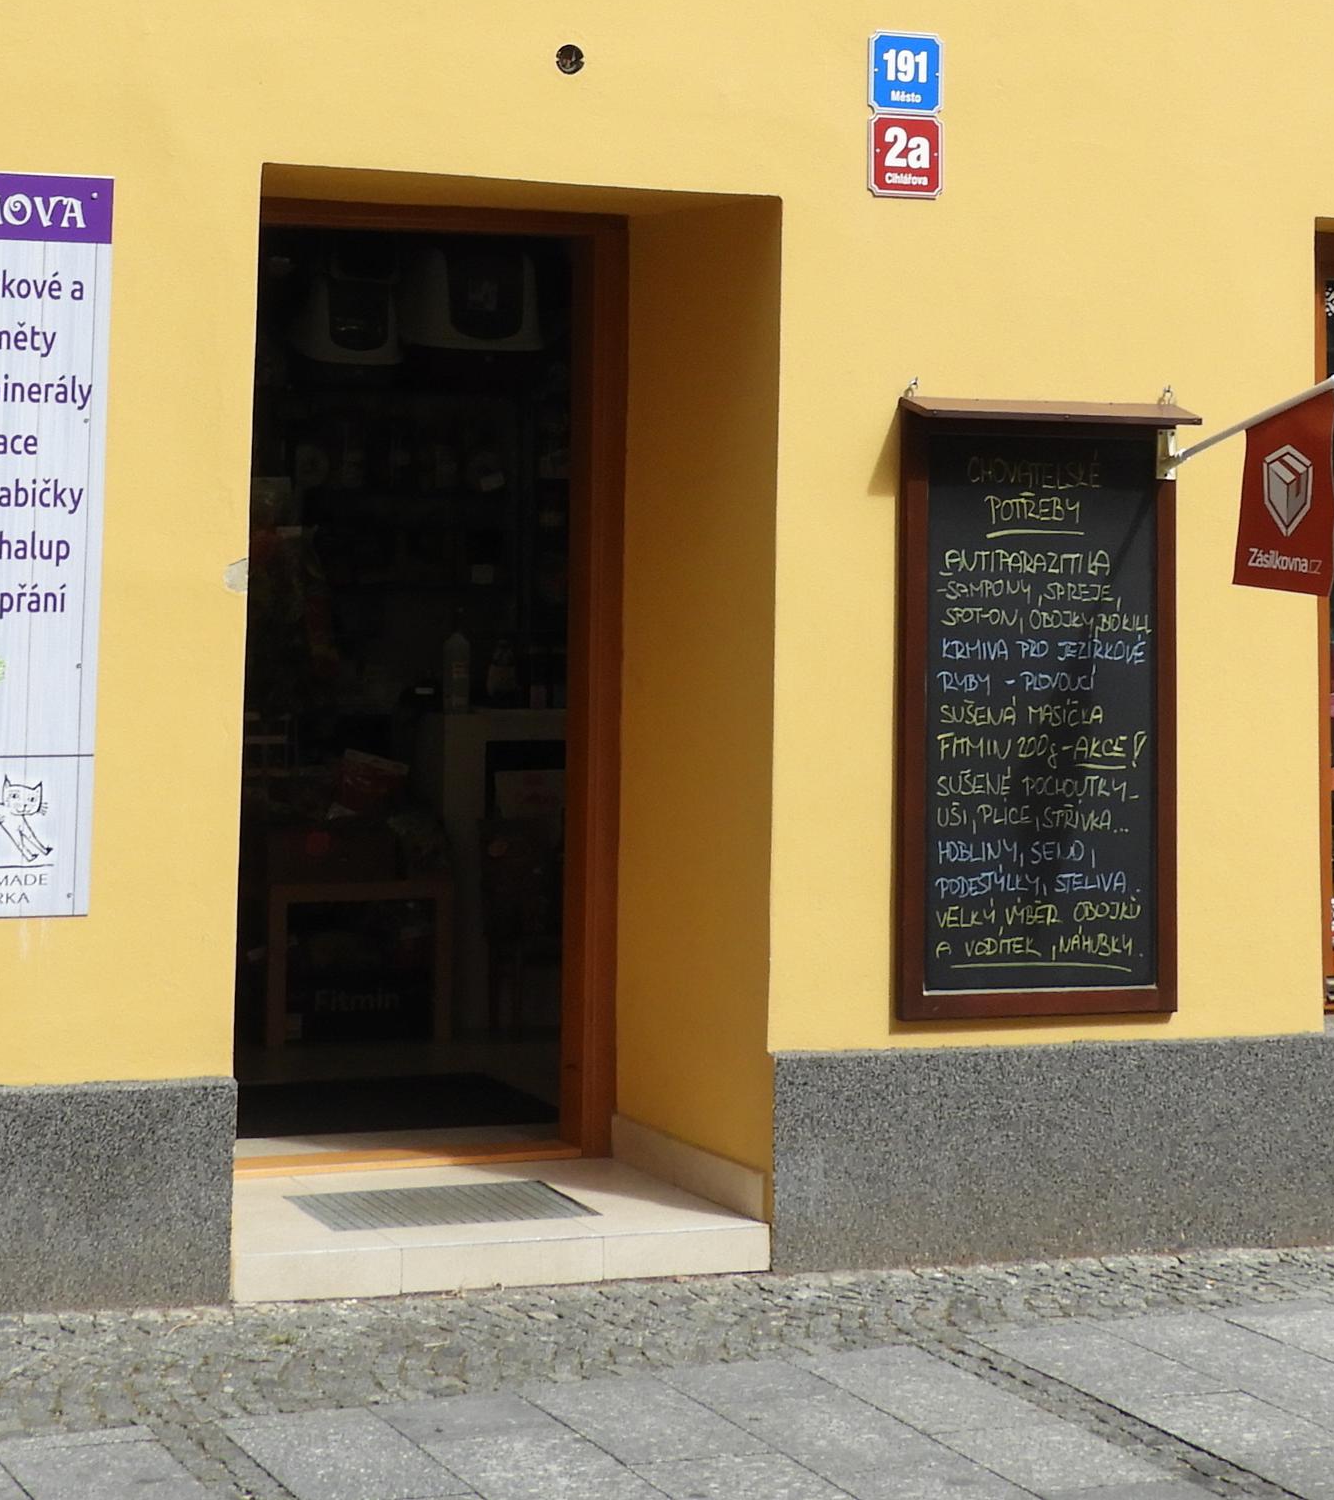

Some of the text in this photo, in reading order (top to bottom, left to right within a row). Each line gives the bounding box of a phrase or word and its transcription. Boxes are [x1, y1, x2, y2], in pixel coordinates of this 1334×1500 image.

[883, 49, 928, 83] 191
[884, 126, 930, 169] 2a
[70, 279, 84, 300] a
[984, 491, 1080, 524] POTŘEBY
[0, 584, 66, 619] přání
[942, 638, 1008, 661] KRMIVA
[1017, 639, 1048, 659] PRO
[937, 671, 990, 695] RYBY
[940, 696, 1016, 726] SUŠENÁ
[937, 766, 1011, 797] SUŠENÉ
